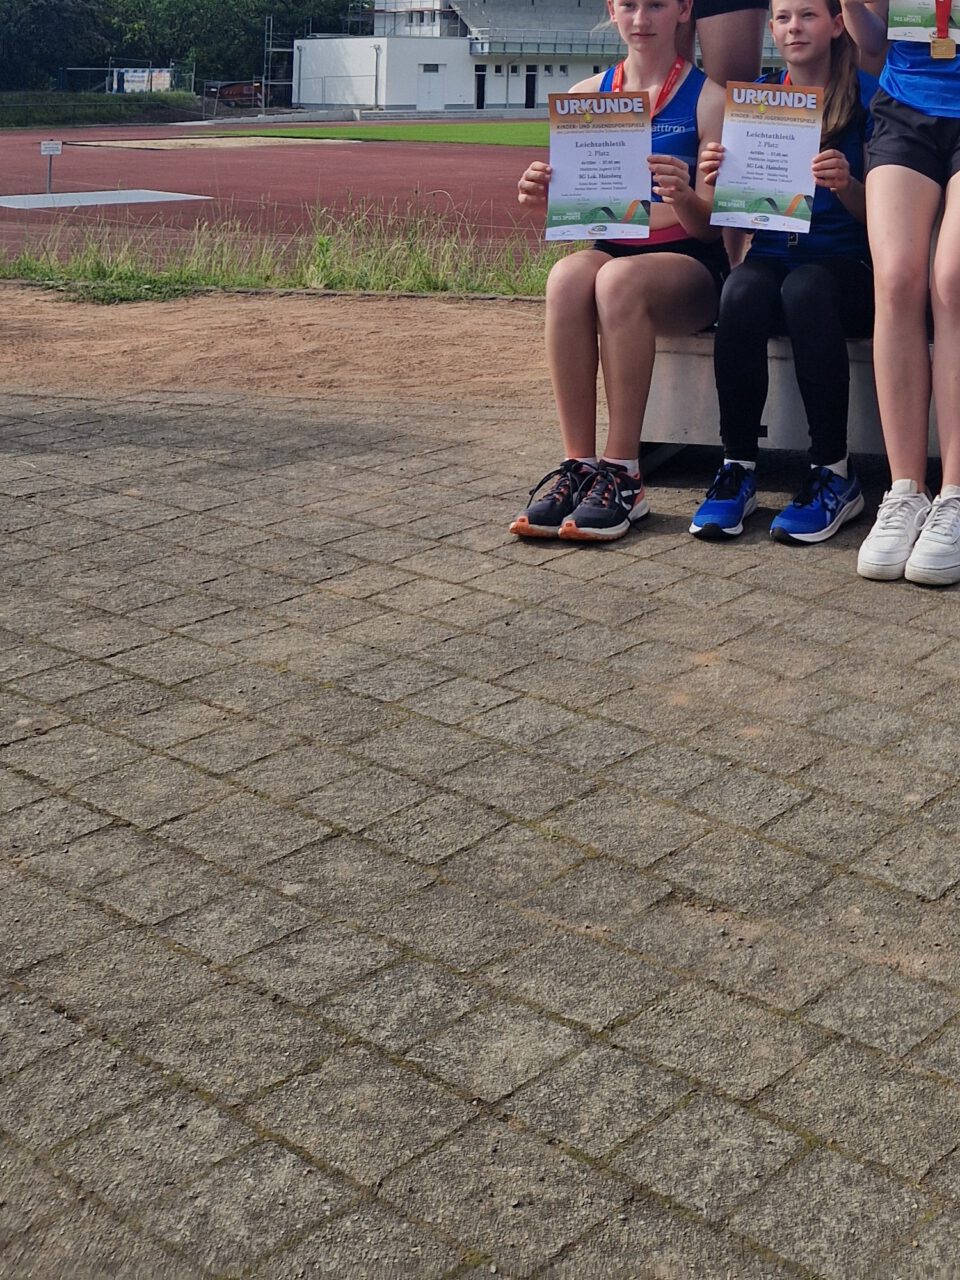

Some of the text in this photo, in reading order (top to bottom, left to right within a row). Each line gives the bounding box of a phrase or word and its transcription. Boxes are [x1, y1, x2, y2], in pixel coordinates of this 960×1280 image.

[733, 88, 816, 109] URKUNDE
[556, 97, 644, 115] URKUNDE
[652, 125, 686, 133] attron
[746, 131, 795, 141] Leichtathletik
